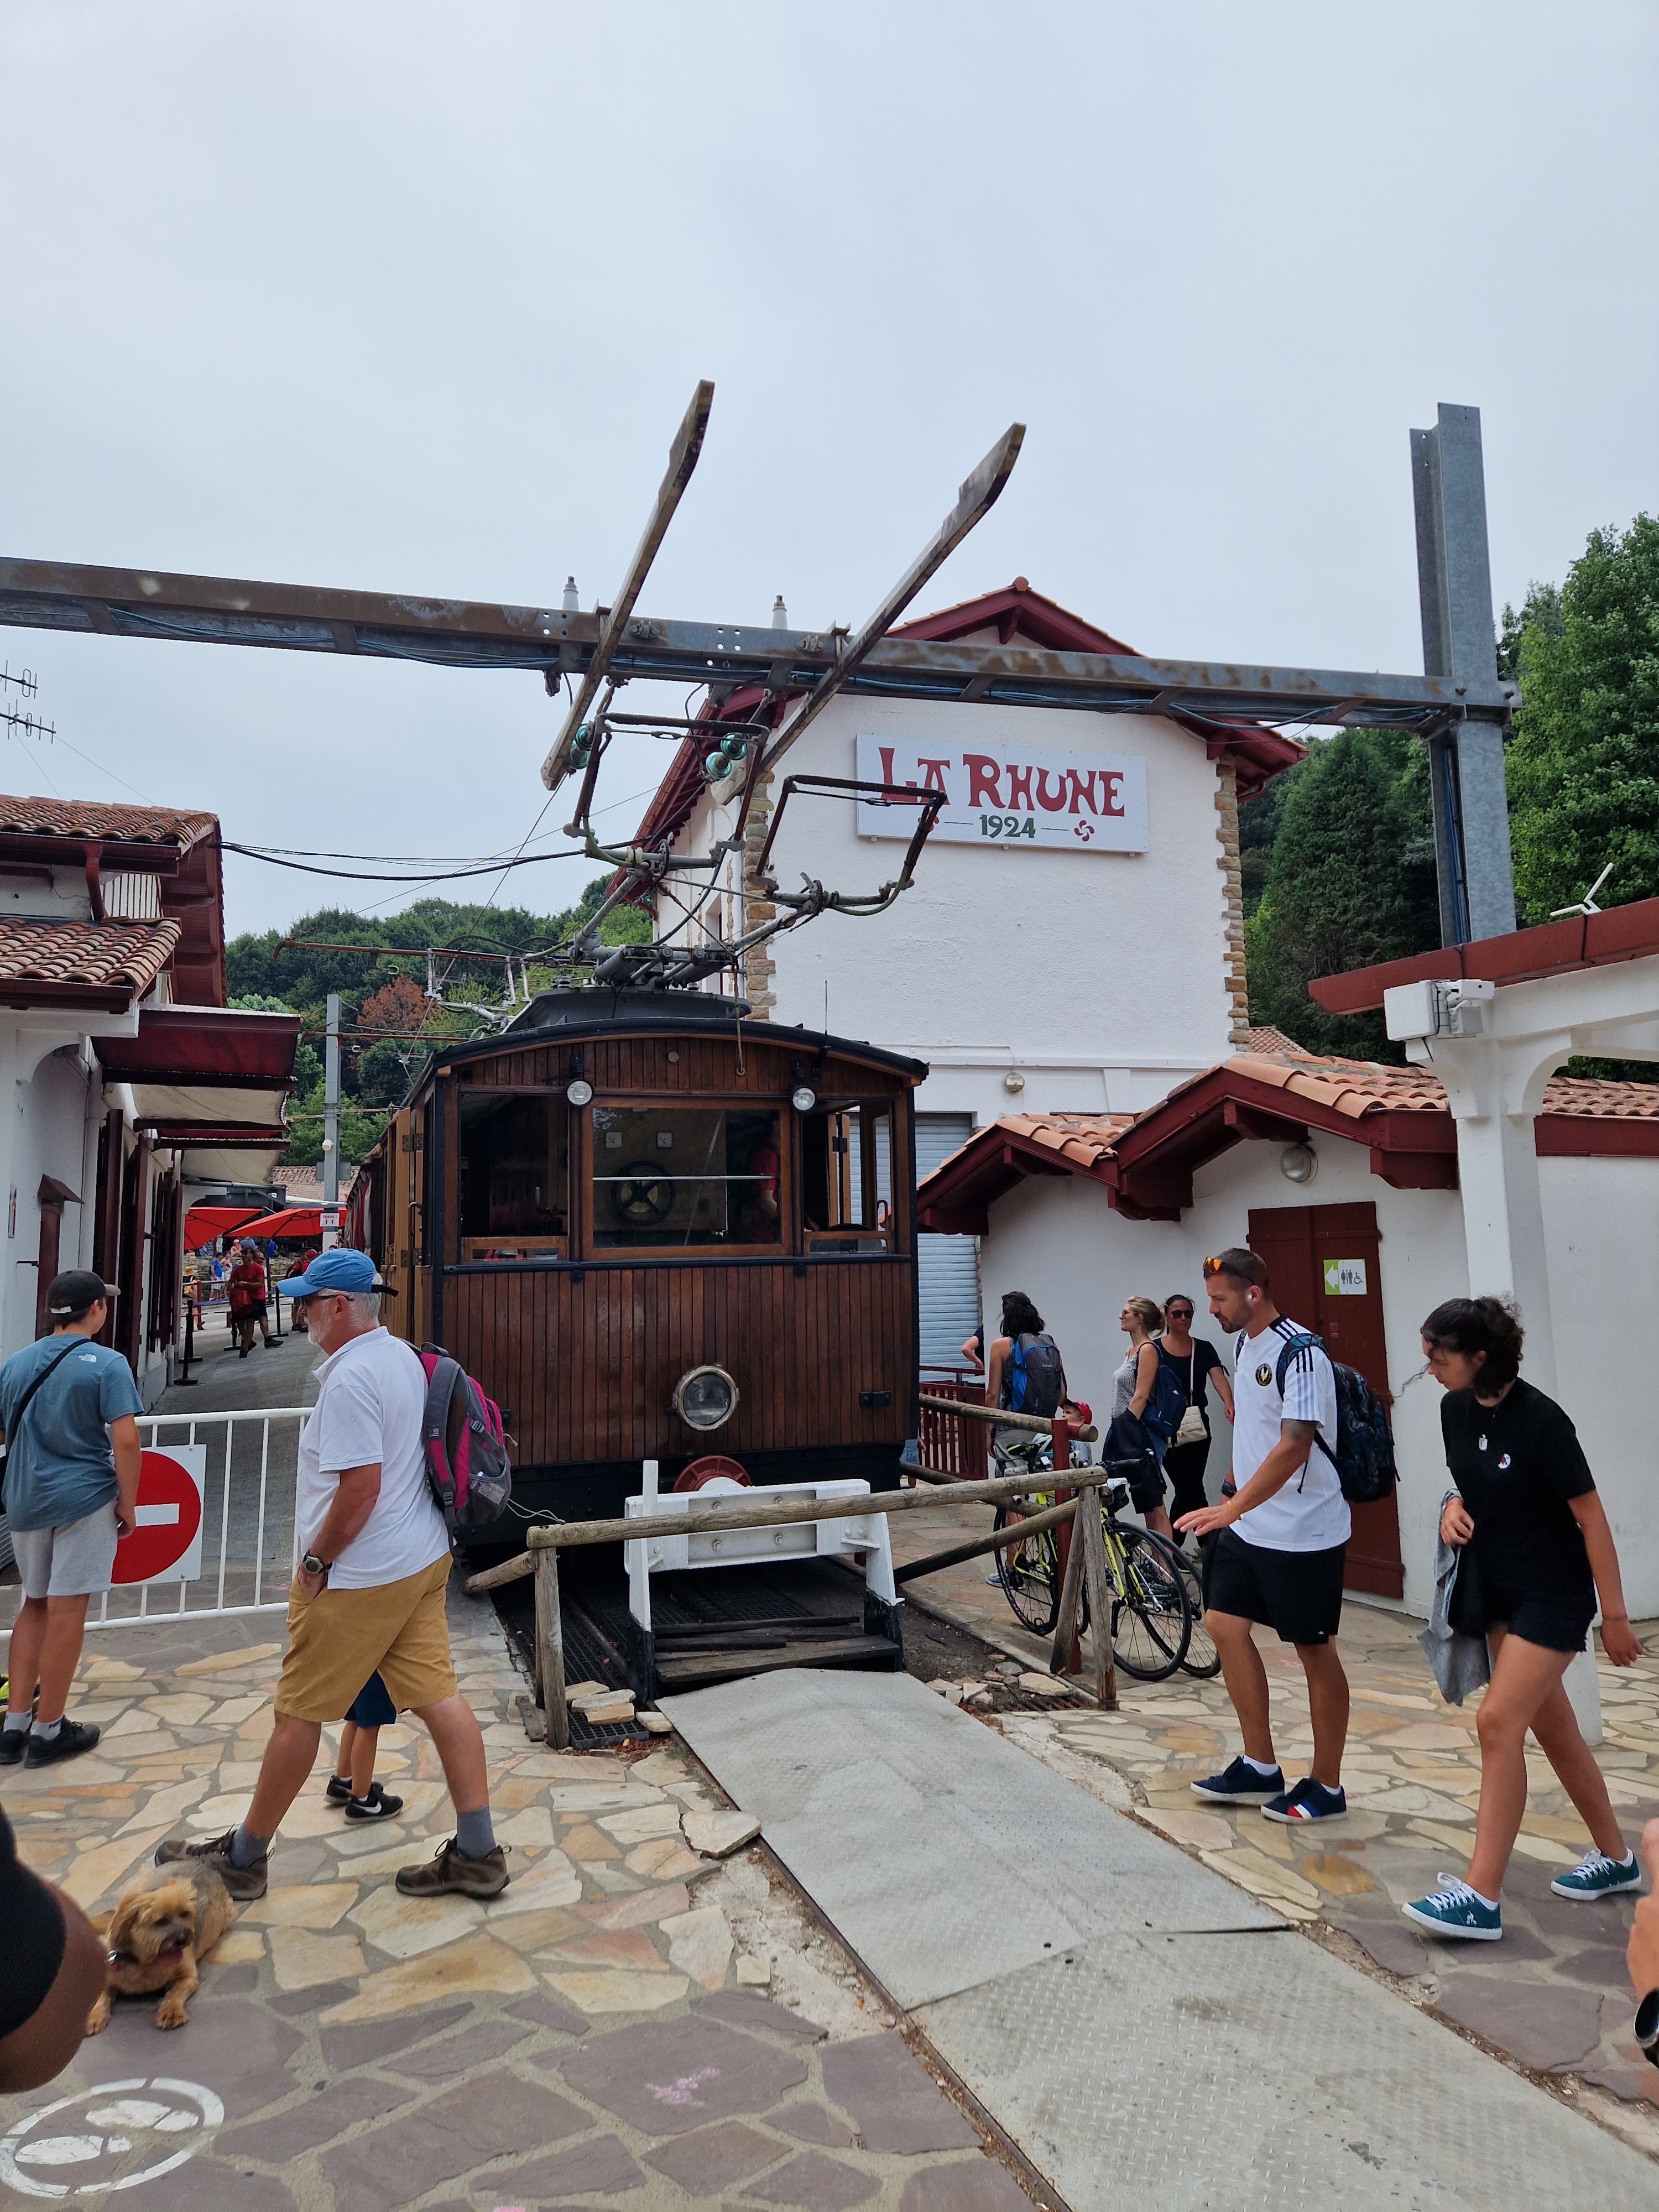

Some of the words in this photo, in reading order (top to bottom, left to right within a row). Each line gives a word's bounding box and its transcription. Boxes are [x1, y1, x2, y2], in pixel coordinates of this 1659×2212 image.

[878, 747, 951, 805] LA
[963, 754, 1125, 817] RHUNE
[979, 814, 1036, 839] 1924
